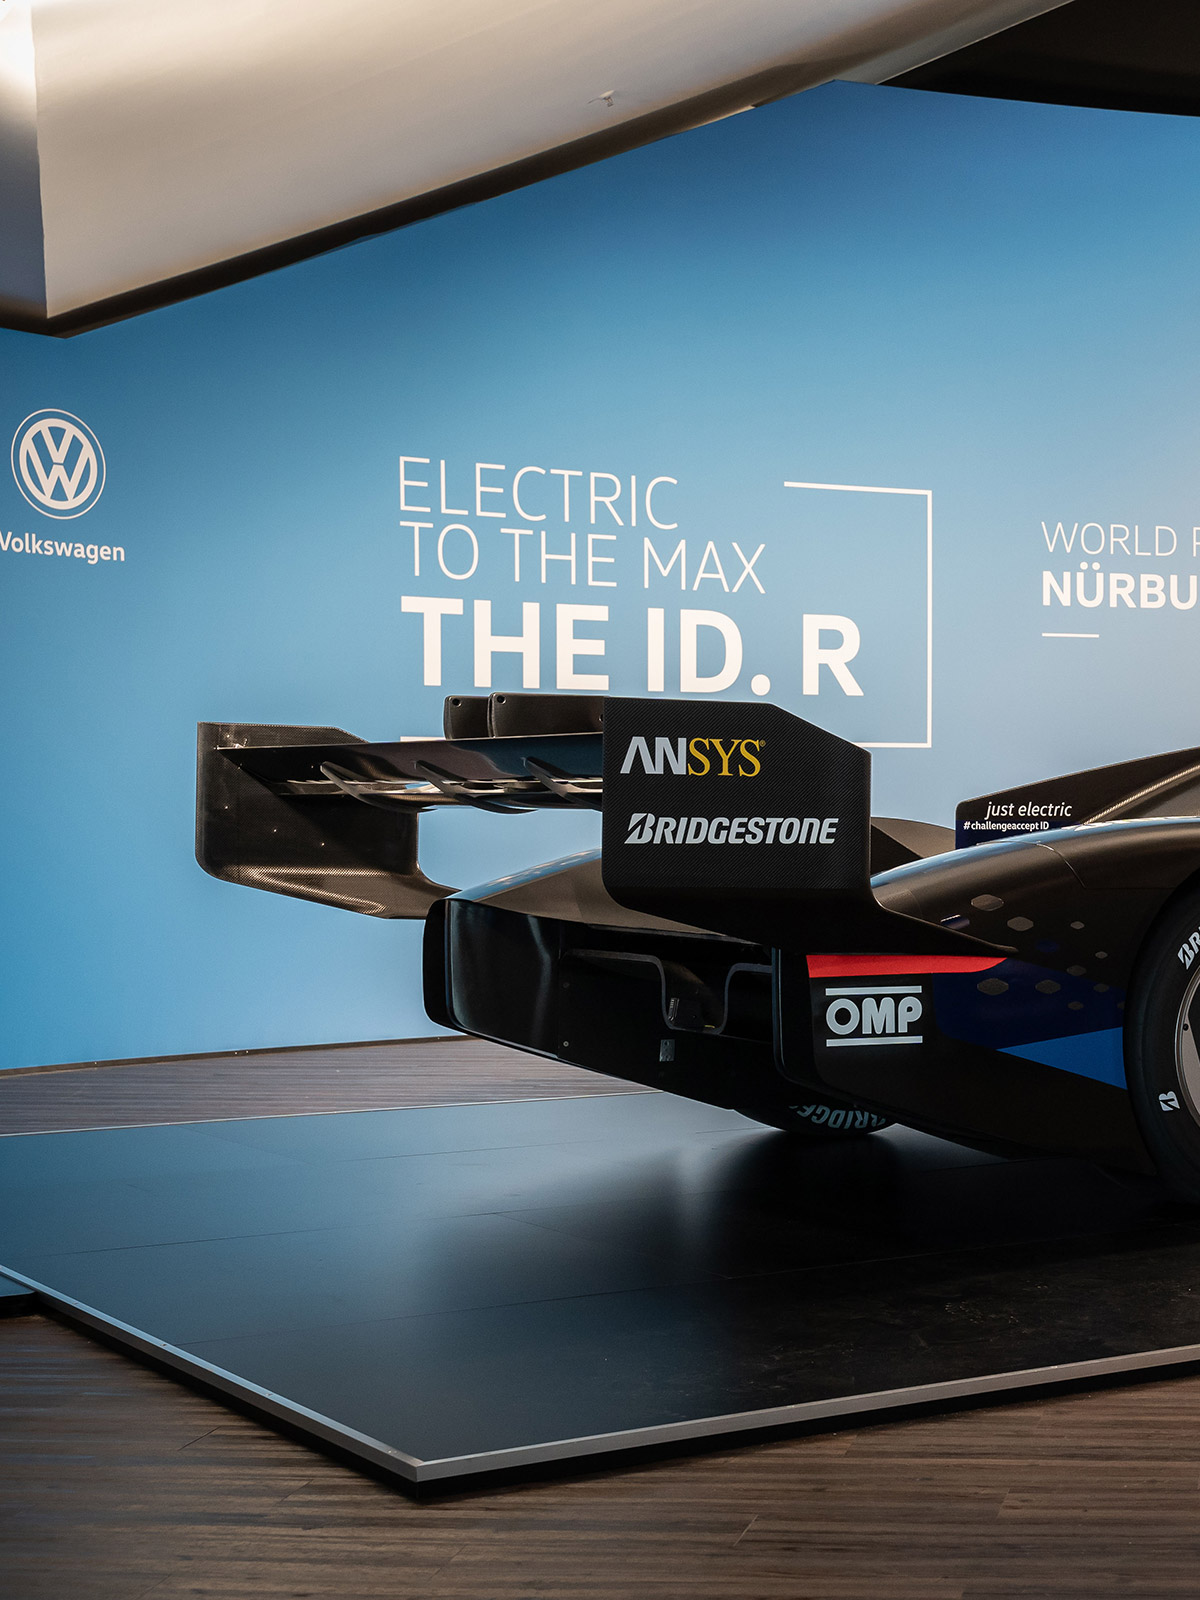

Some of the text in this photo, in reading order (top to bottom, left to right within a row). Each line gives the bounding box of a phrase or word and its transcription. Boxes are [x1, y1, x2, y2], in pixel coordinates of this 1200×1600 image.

[399, 455, 679, 530] ELECTRIC
[0, 531, 125, 565] Volkswagen
[399, 520, 767, 595] TO THE MAX
[1041, 521, 1178, 558] WORLD
[400, 596, 865, 697] THE ID. R
[624, 812, 839, 844] BRIDGESTONE
[983, 801, 1073, 820] just electric
[825, 996, 923, 1036] OMP
